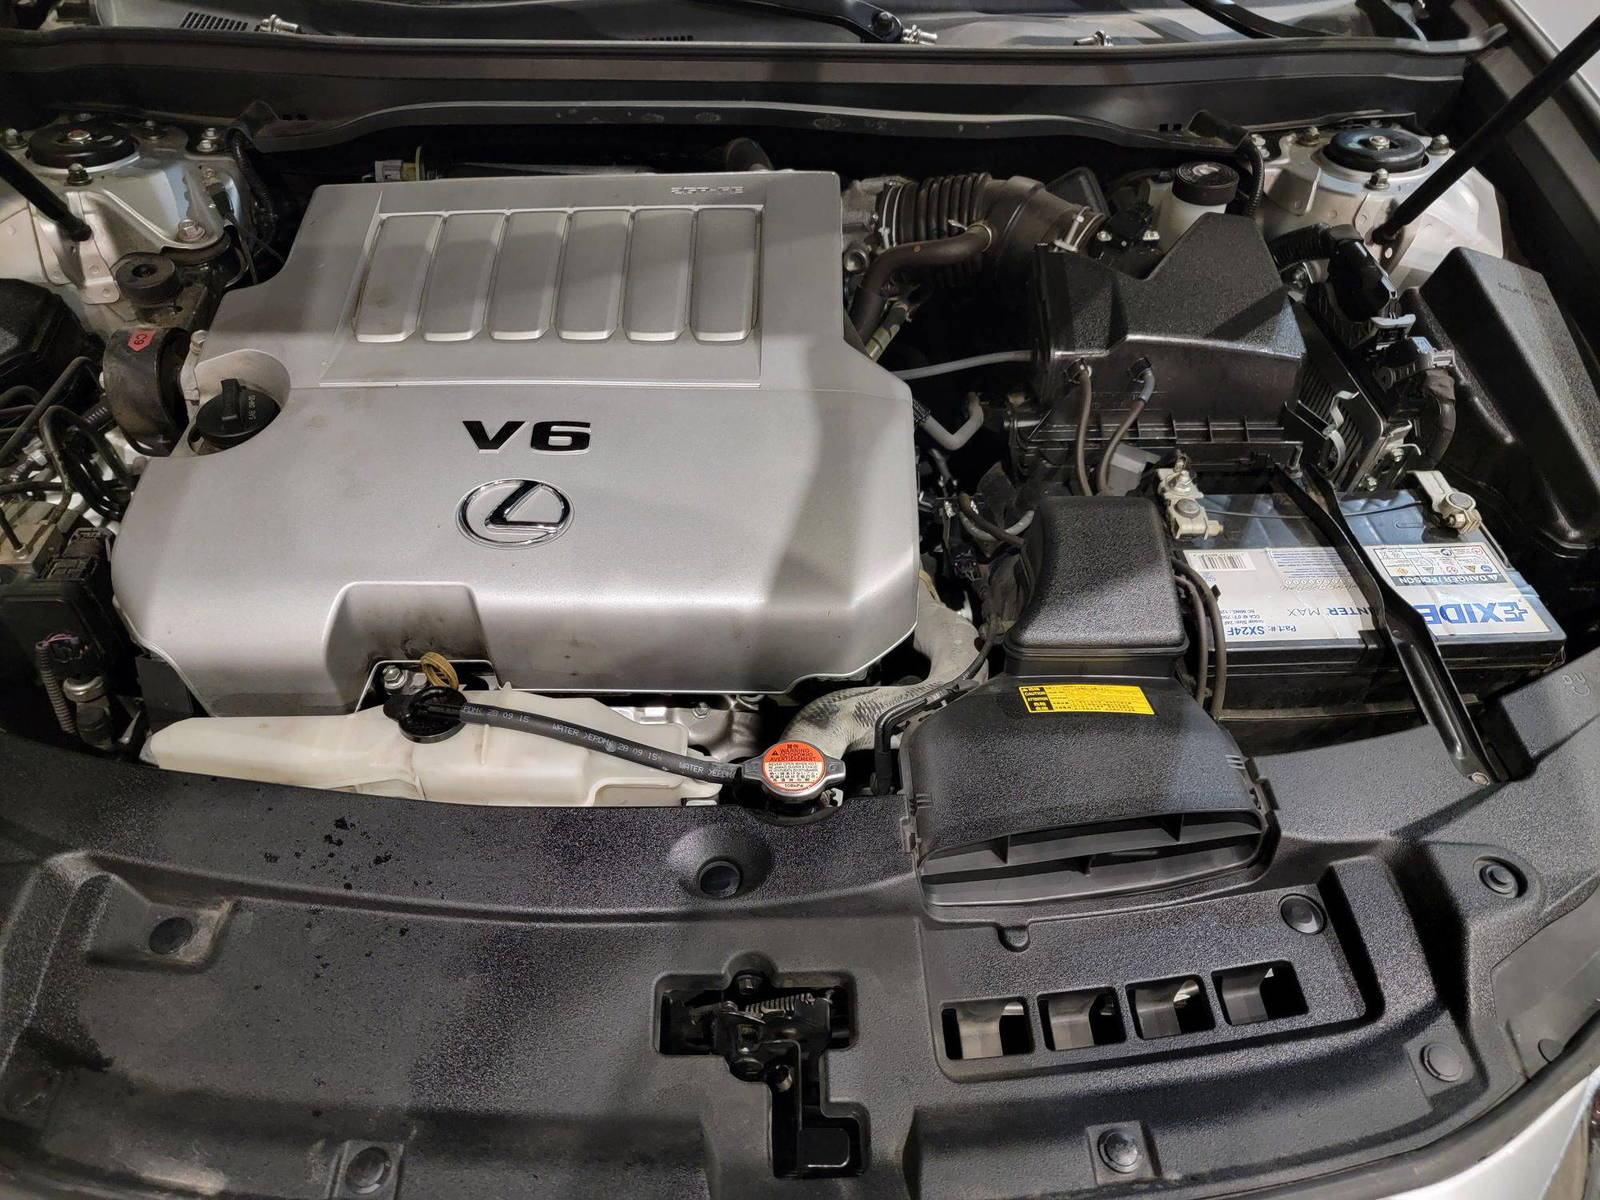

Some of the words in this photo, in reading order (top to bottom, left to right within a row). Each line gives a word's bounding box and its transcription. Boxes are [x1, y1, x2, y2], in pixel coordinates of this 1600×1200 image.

[462, 420, 591, 453] V6
[1446, 573, 1489, 584] DANGER
[1287, 607, 1321, 617] MAX
[1413, 601, 1529, 625] EXIDE
[1226, 625, 1265, 636] SX24F
[552, 723, 580, 738] WATER
[678, 761, 705, 774] WATER
